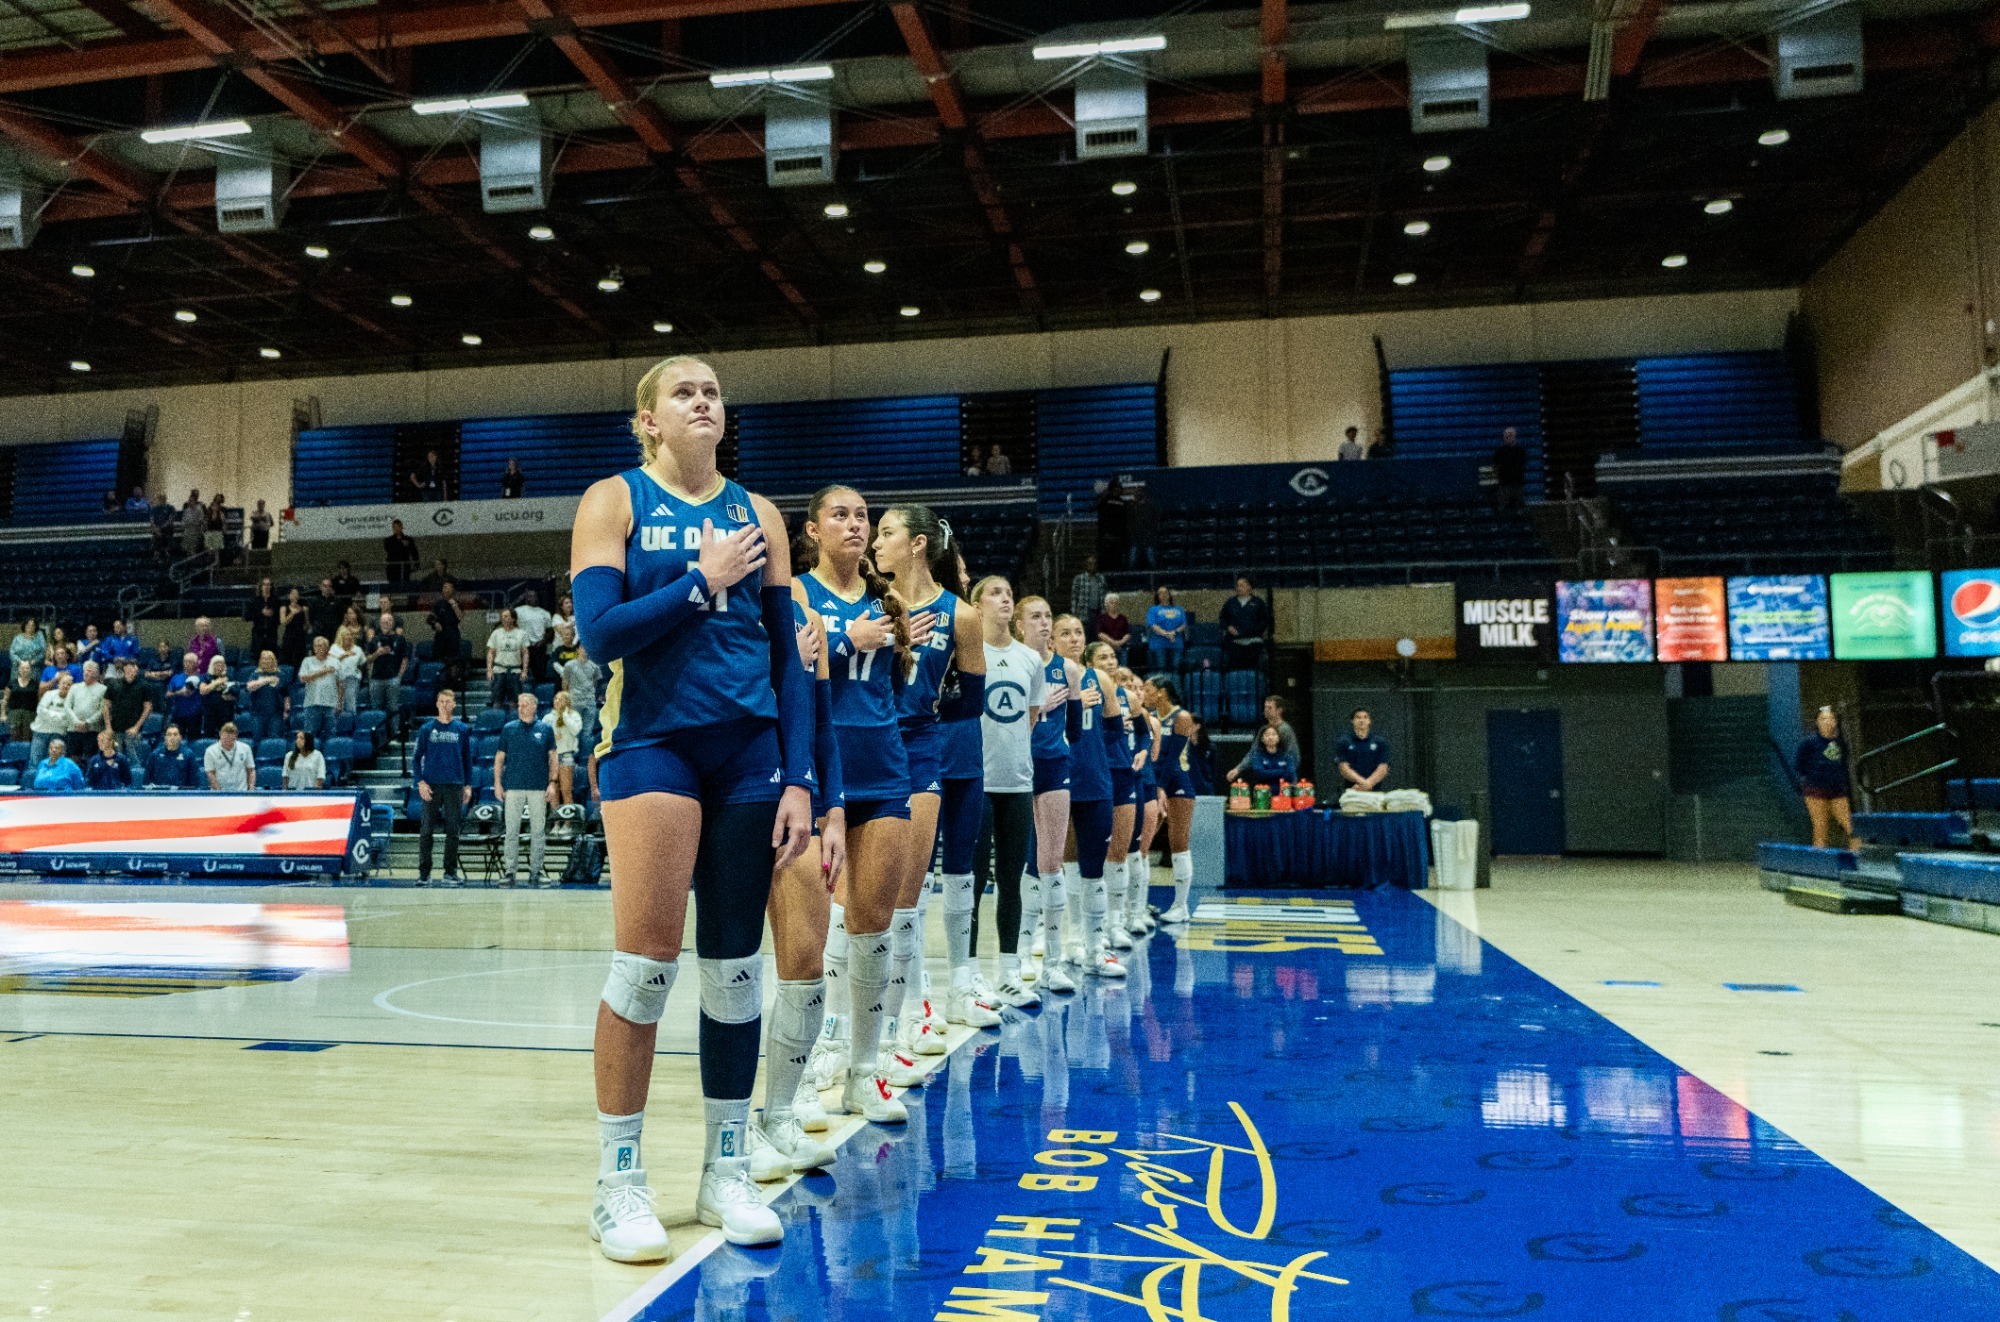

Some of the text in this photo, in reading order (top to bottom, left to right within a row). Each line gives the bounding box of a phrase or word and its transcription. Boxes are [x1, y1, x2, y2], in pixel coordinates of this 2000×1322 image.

[495, 510, 544, 522] ucu.org
[641, 526, 677, 551] UC
[1463, 599, 1550, 624] MUSCLE
[1569, 609, 1606, 621] Show
[1480, 623, 1538, 647] MILK
[848, 649, 877, 682] 17
[933, 1128, 1118, 1322] BOB HAM
